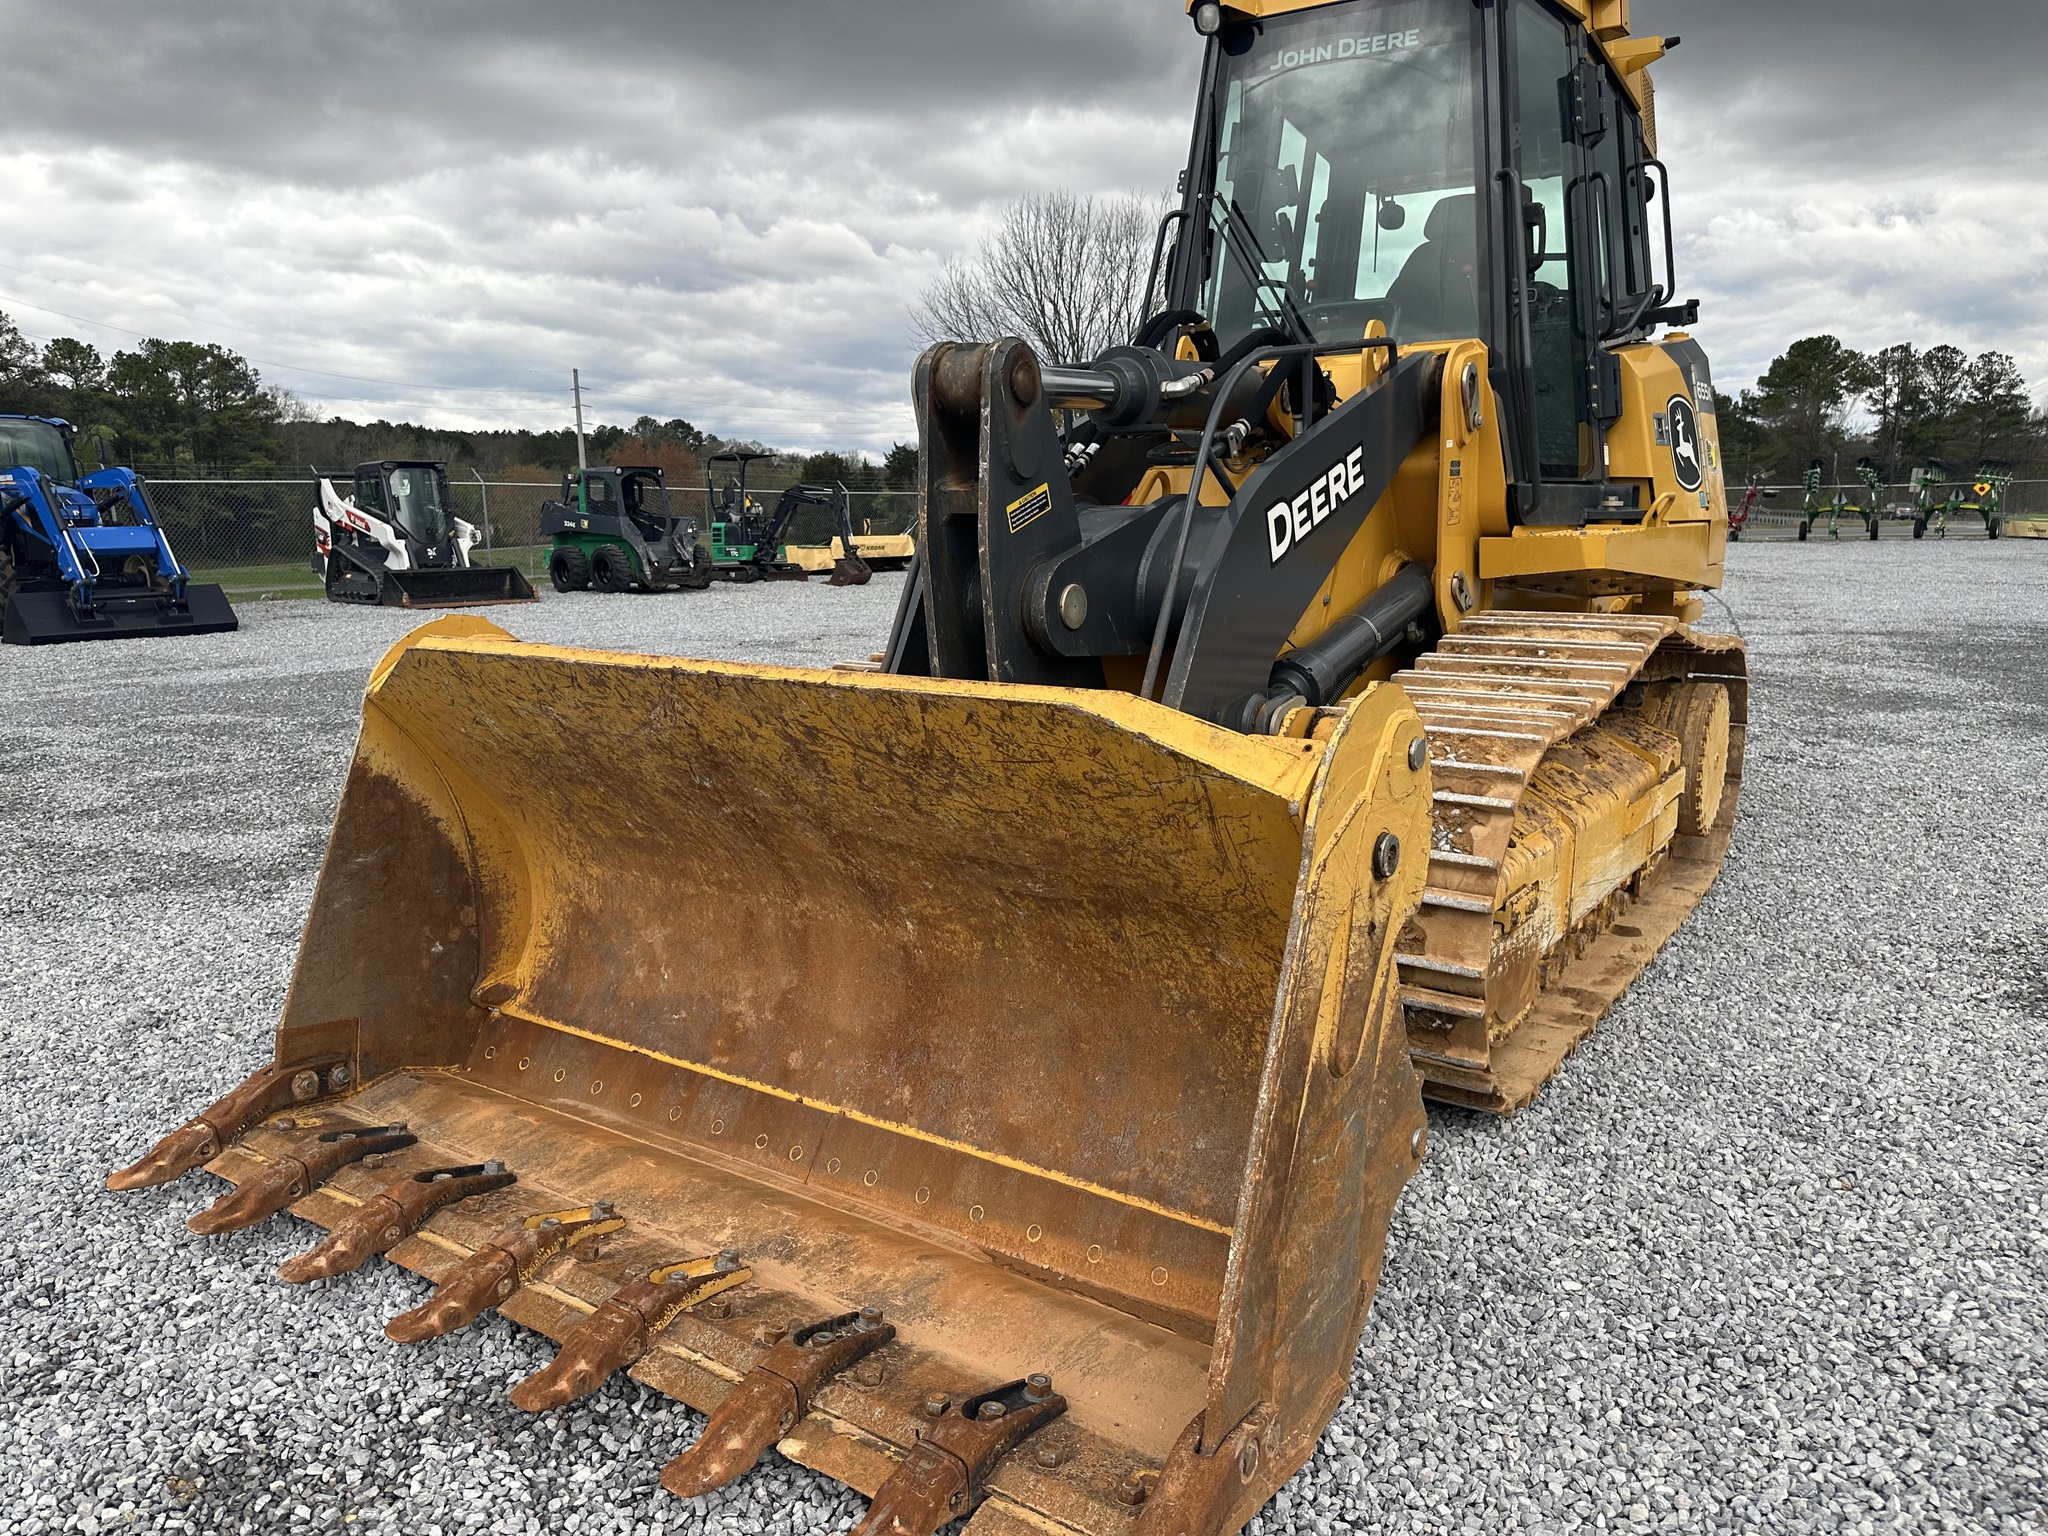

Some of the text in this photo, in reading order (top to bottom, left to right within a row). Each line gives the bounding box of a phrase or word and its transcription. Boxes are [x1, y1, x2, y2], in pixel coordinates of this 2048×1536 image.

[1269, 29, 1420, 71] JOHN DEERE
[1267, 445, 1365, 563] DEERE
